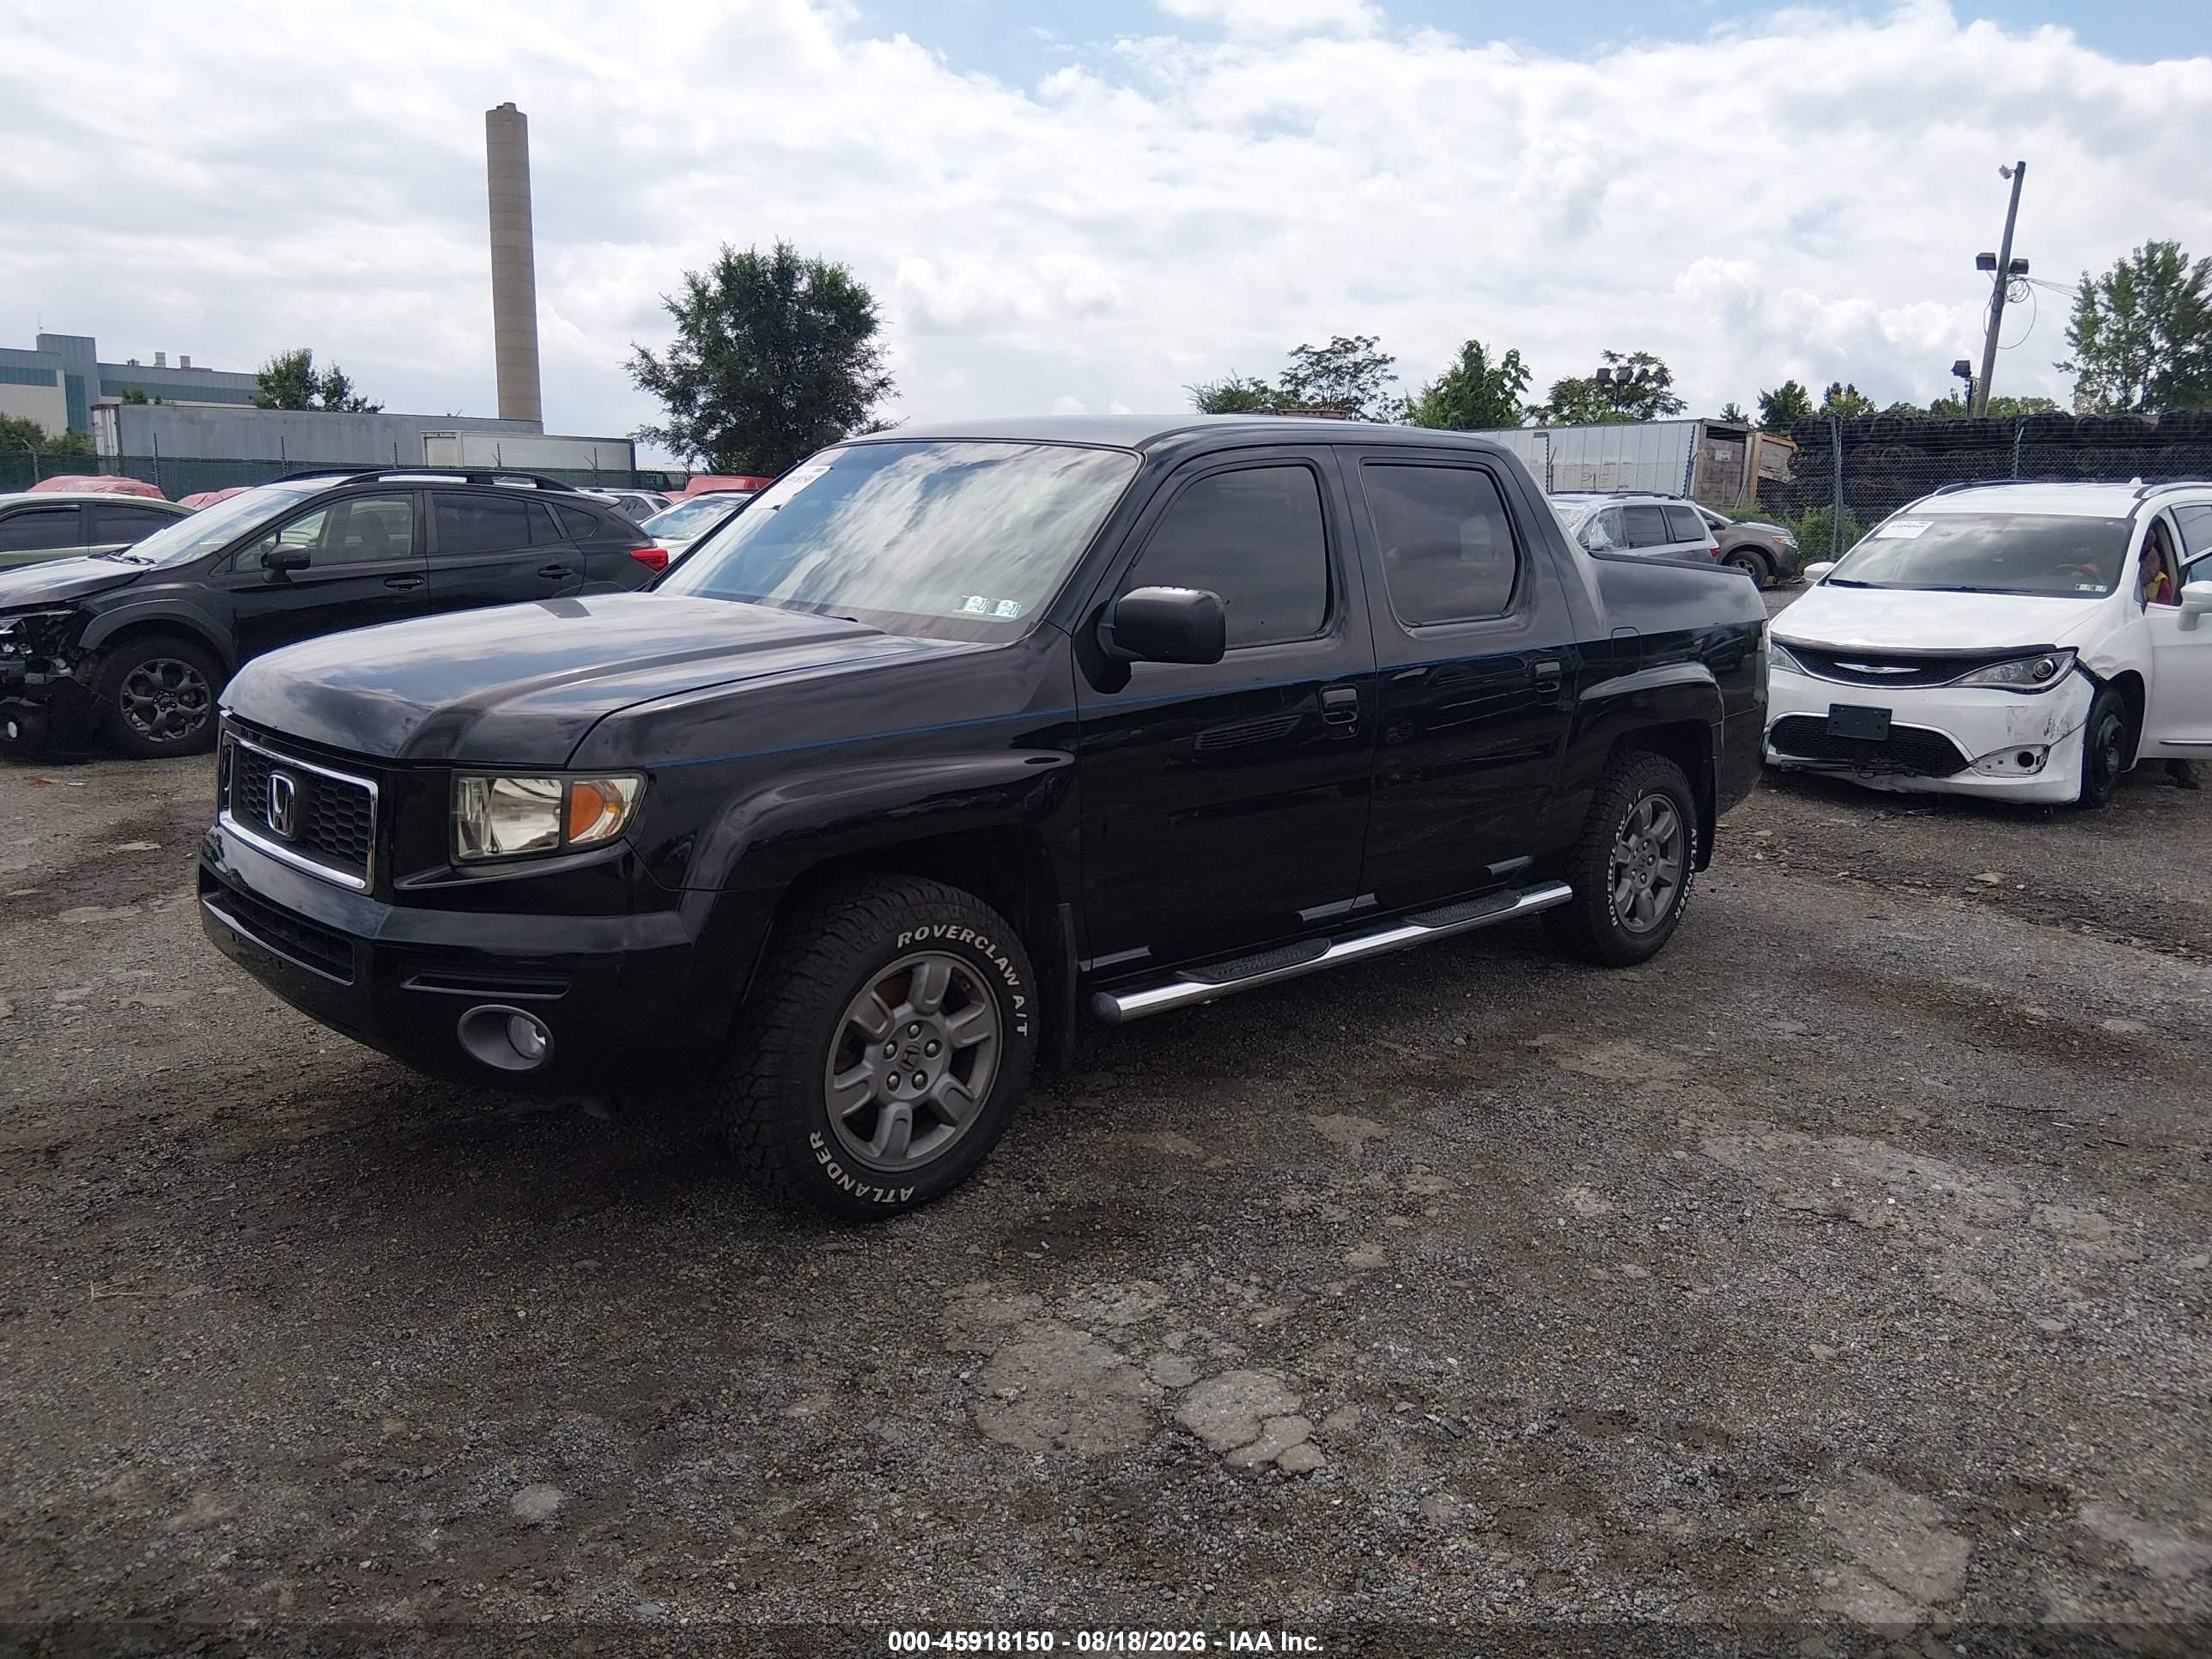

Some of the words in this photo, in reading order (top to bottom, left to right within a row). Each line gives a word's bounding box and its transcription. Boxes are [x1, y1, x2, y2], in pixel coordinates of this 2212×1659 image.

[1674, 828, 1698, 920] ATLANDER
[897, 925, 1020, 987] ROVERCLAW
[1012, 994, 1028, 1037] A/T
[810, 1130, 915, 1203] ATLANDER
